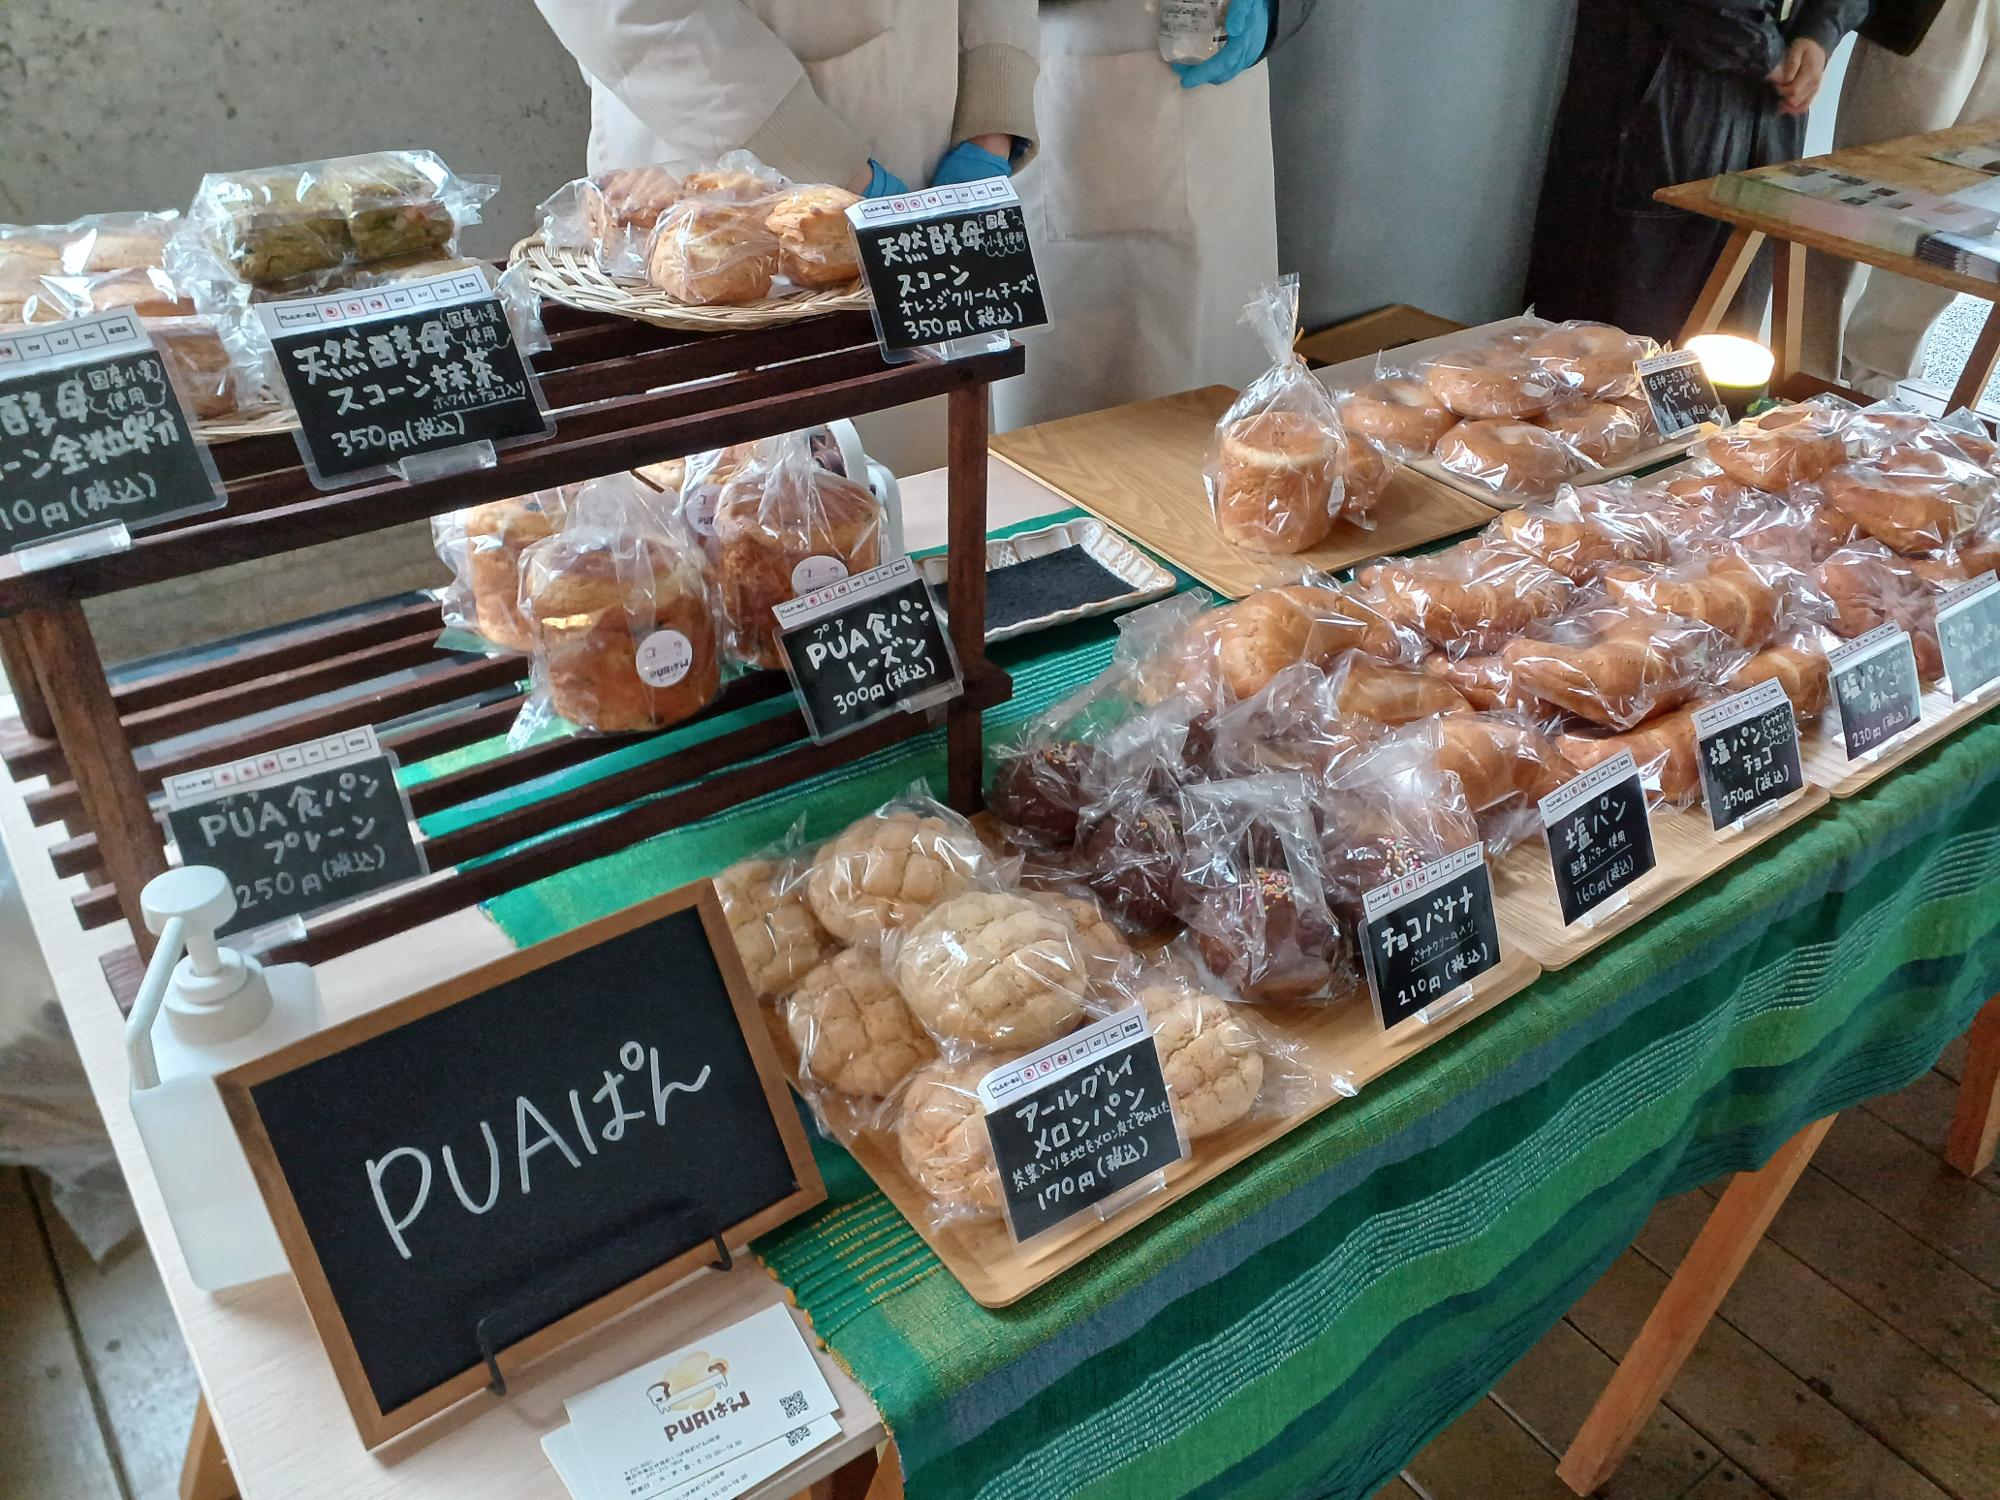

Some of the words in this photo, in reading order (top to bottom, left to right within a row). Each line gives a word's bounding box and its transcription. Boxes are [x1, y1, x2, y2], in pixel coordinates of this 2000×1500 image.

[878, 220, 984, 267] 天然酵母
[897, 265, 970, 297] スコーン
[899, 273, 1035, 317] オレンジクリームチーズ
[448, 306, 501, 330] 国産小麦
[466, 328, 498, 345] 使用
[293, 321, 451, 386] 天然酵母
[433, 380, 526, 410] ホワイトチョコ入り
[1662, 381, 1702, 402] ベーグル
[848, 637, 926, 684] レーズン
[1709, 726, 1762, 766] 塩パン
[1742, 747, 1773, 775] チョコ
[264, 817, 376, 865] プレーン
[1565, 796, 1627, 853] 塩パン
[1380, 886, 1474, 958] チョコバナナ
[1016, 1054, 1133, 1133] アールグレイ
[1033, 1087, 1146, 1160] メロンパン
[365, 1040, 712, 1260] PUAぱん
